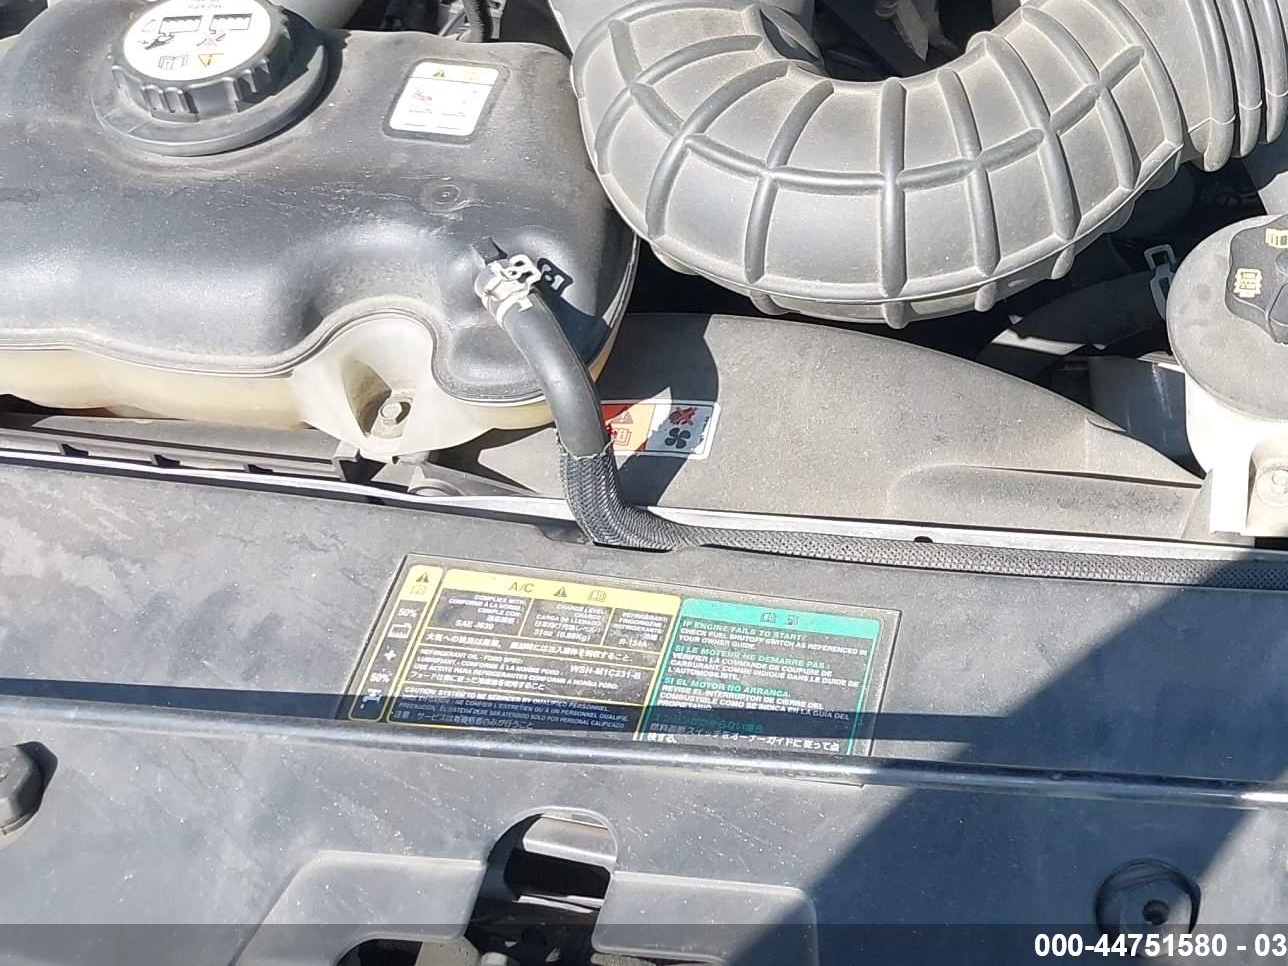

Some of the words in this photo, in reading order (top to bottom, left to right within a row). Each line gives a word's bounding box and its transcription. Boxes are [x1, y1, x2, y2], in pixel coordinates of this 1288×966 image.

[508, 581, 535, 594] A/C
[397, 607, 418, 619] 50%
[455, 619, 474, 628] SAE
[694, 622, 729, 631] ENGINE
[731, 627, 756, 635] FAILS
[680, 628, 707, 636] CHECK
[708, 631, 728, 639] FUEL
[729, 634, 764, 643] SHUTOFF
[765, 638, 794, 647] SWITCH
[807, 643, 858, 654] REFERENCED
[701, 638, 730, 646] OWNER
[700, 648, 740, 658] MOTEUR
[709, 656, 721, 664] LA
[721, 658, 767, 669] COMMANDE
[781, 665, 820, 675] COUPURE
[369, 672, 392, 683] 50%
[821, 678, 847, 686] GUIDE
[676, 678, 689, 686] EL
[690, 680, 726, 690] MOTOR
[727, 684, 742, 692] NO
[661, 685, 691, 694] REVISE
[705, 690, 762, 702] INTERRUPTOR
[776, 698, 807, 707] CIERRE
[807, 701, 825, 709] DEL
[659, 692, 718, 704] COMBUSTIBLE
[719, 699, 745, 708] COMO
[758, 704, 786, 712] INDICA
[834, 712, 849, 720] DEL
